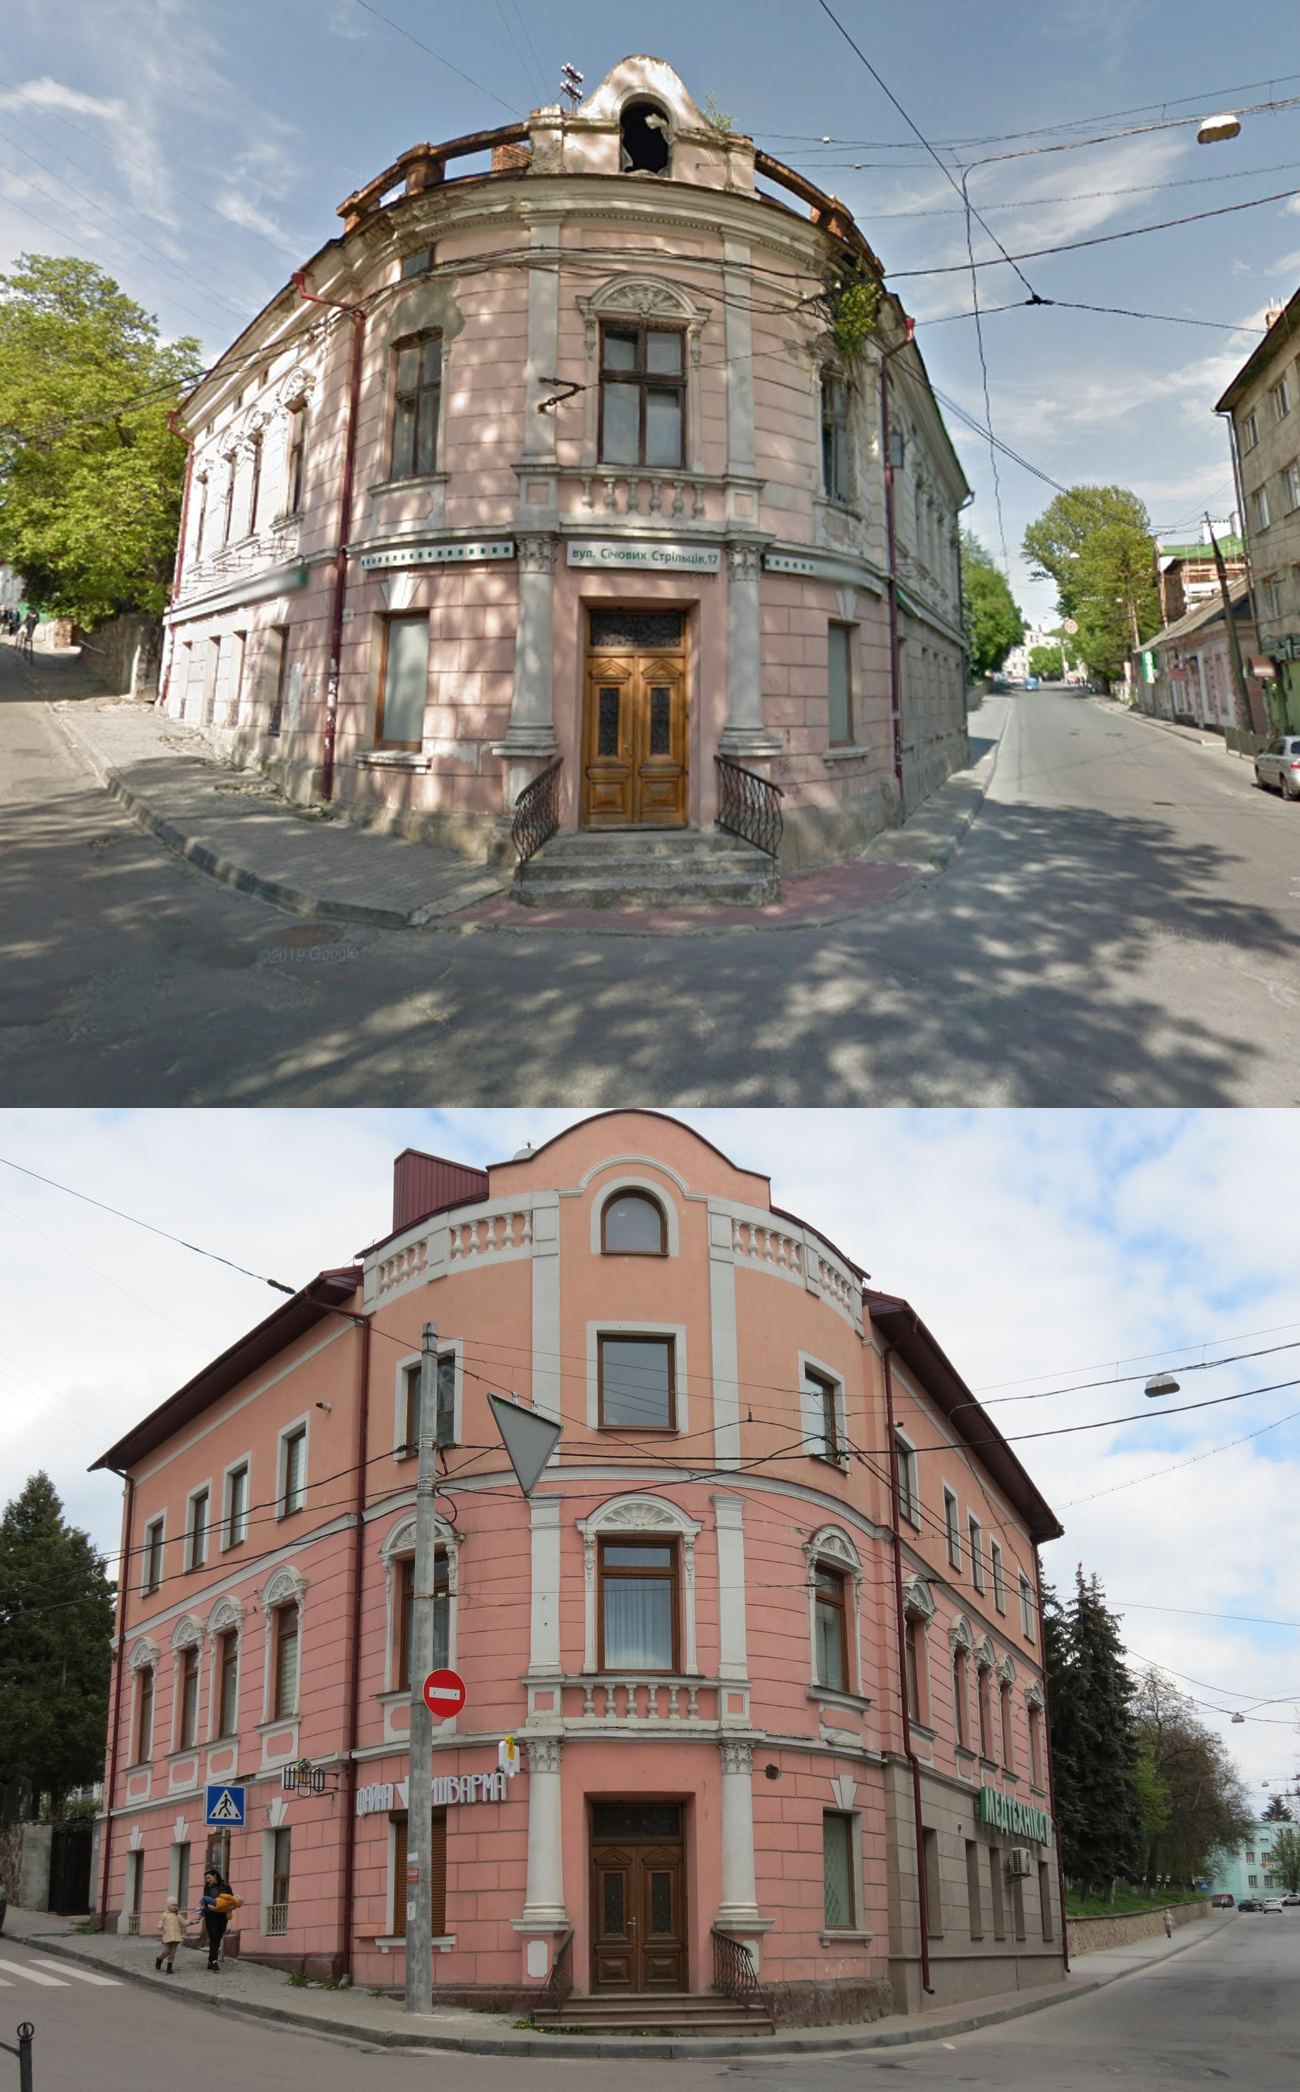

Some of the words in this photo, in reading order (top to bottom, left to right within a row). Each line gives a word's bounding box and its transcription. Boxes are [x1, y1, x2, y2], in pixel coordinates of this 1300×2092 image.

[572, 549, 596, 561] вул.
[600, 548, 647, 561] Січових
[356, 1782, 394, 1817] ФАЙНА
[433, 1772, 506, 1805] ШВАРМА
[985, 1787, 1046, 1845] МЕДТЕХНІКА
